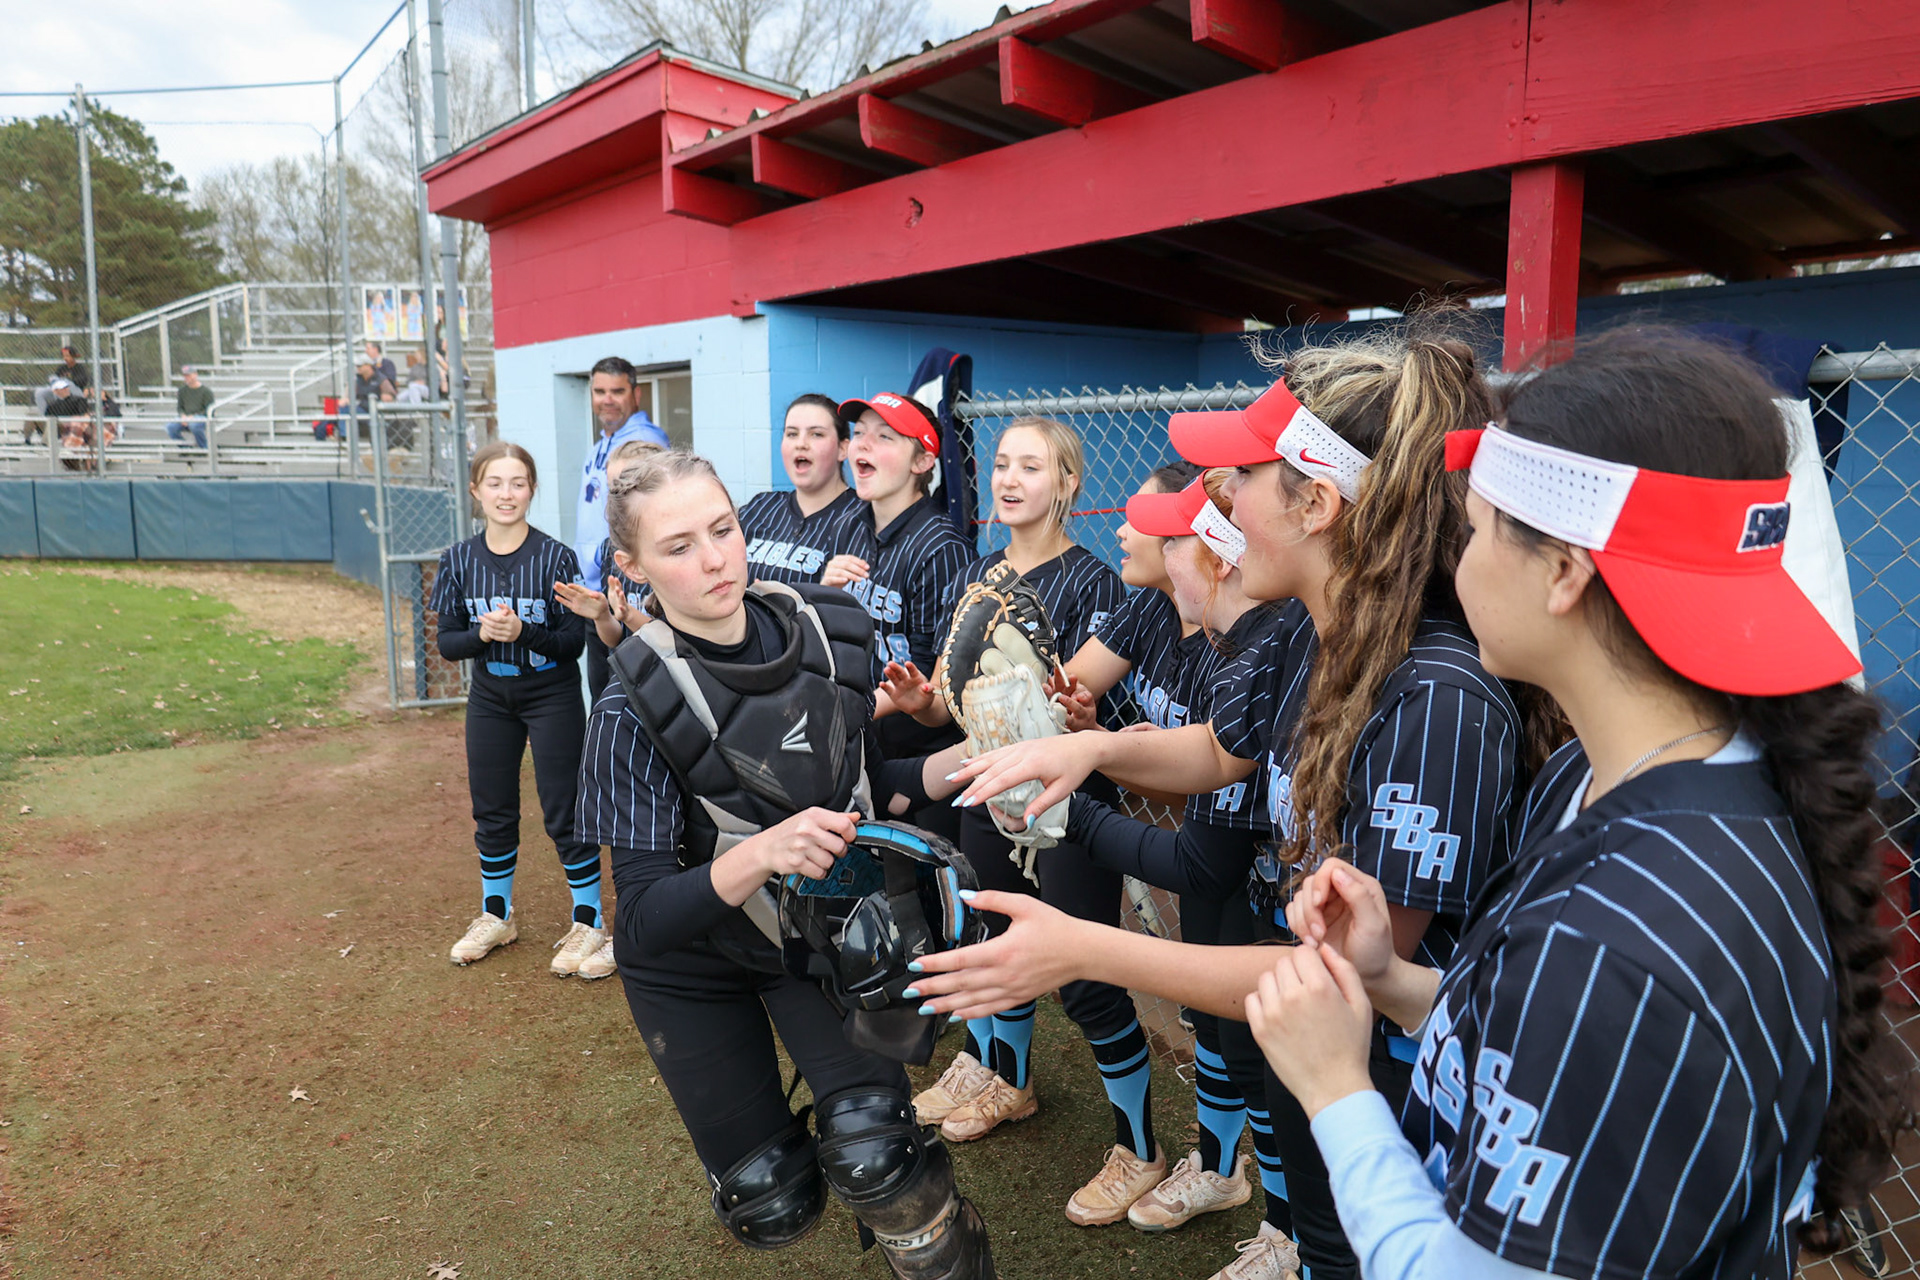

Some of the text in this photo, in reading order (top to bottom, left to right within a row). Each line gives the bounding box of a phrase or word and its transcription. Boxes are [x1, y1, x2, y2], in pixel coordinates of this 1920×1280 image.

[746, 538, 825, 575] EAGLES
[842, 577, 903, 624] GLES
[1134, 666, 1190, 729] EAGLE
[1370, 783, 1461, 883] SBA
[1473, 1047, 1571, 1227] SBA
